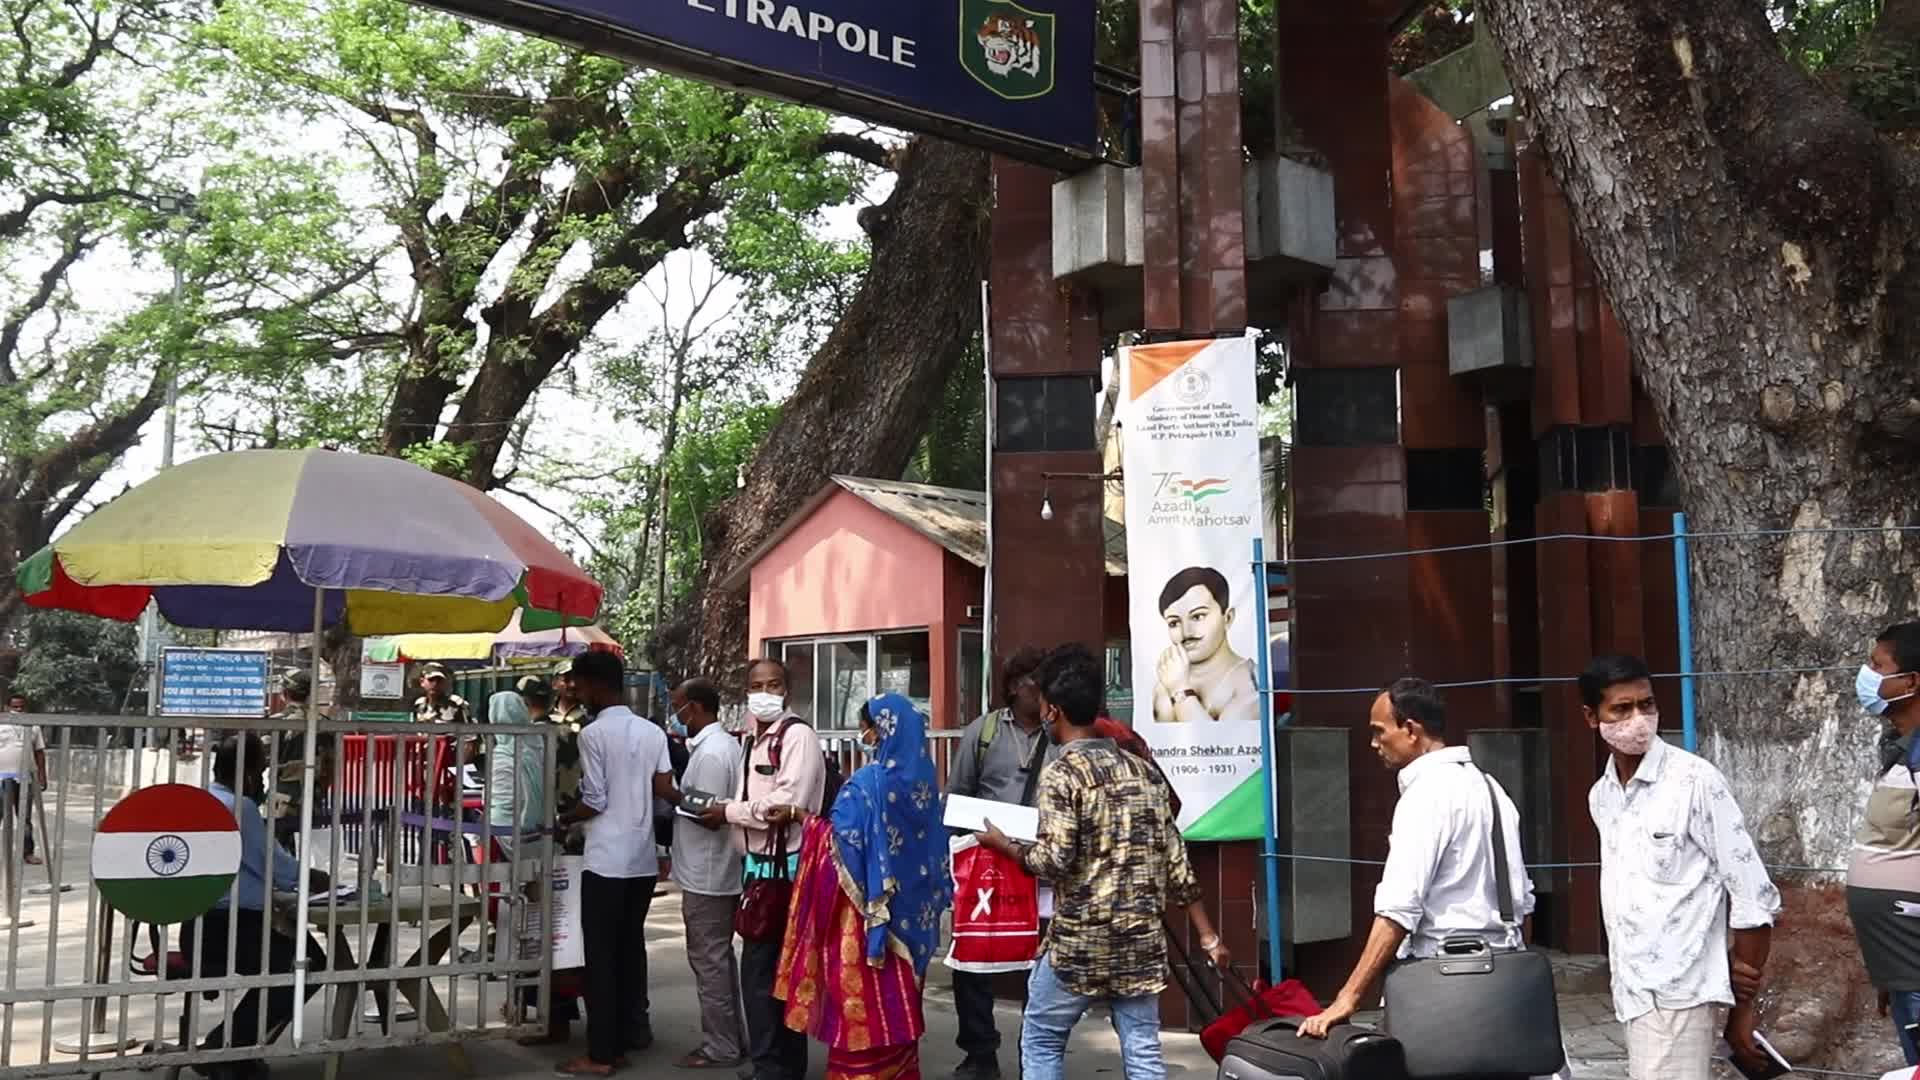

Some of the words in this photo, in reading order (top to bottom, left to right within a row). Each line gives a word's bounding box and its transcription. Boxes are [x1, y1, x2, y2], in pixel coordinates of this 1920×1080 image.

[1212, 402, 1232, 410] India
[1146, 413, 1177, 422] Ministry
[1189, 412, 1211, 420] Home
[1214, 411, 1240, 419] Affairs
[1183, 420, 1220, 430] Authority
[1222, 420, 1231, 428] of
[1232, 419, 1253, 427] India
[1168, 431, 1208, 440] Petrapole
[1152, 500, 1192, 513] Azadi
[1195, 504, 1211, 514] Ka
[1148, 513, 1180, 525] Amrit
[1182, 514, 1251, 527] Mahotsav
[1151, 746, 1187, 757] handra
[1190, 745, 1234, 756] Shekhar
[1171, 764, 1199, 776] (1906
[1209, 763, 1237, 776] 1931)
